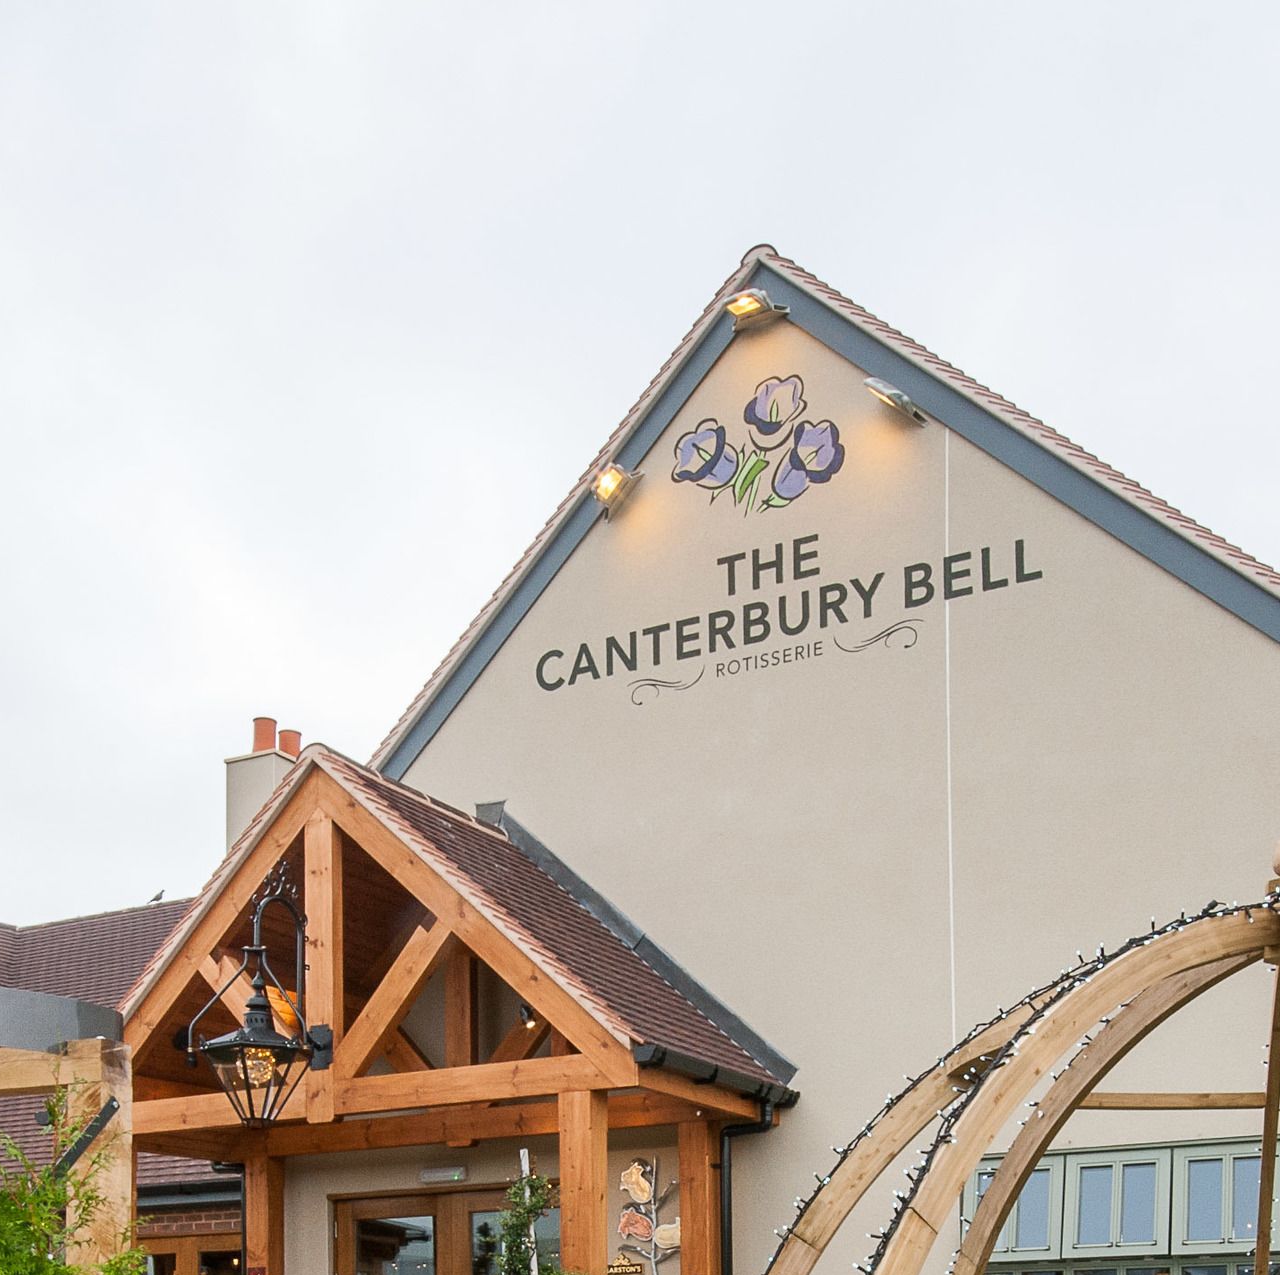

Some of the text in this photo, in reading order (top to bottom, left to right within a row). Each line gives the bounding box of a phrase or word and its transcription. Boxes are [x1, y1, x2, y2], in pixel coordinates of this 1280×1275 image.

[717, 533, 821, 597] THE
[535, 538, 1044, 692] CANTERBURY BELL
[715, 640, 824, 678] ROTISSERIE
[607, 1265, 642, 1273] ARSTON'S
